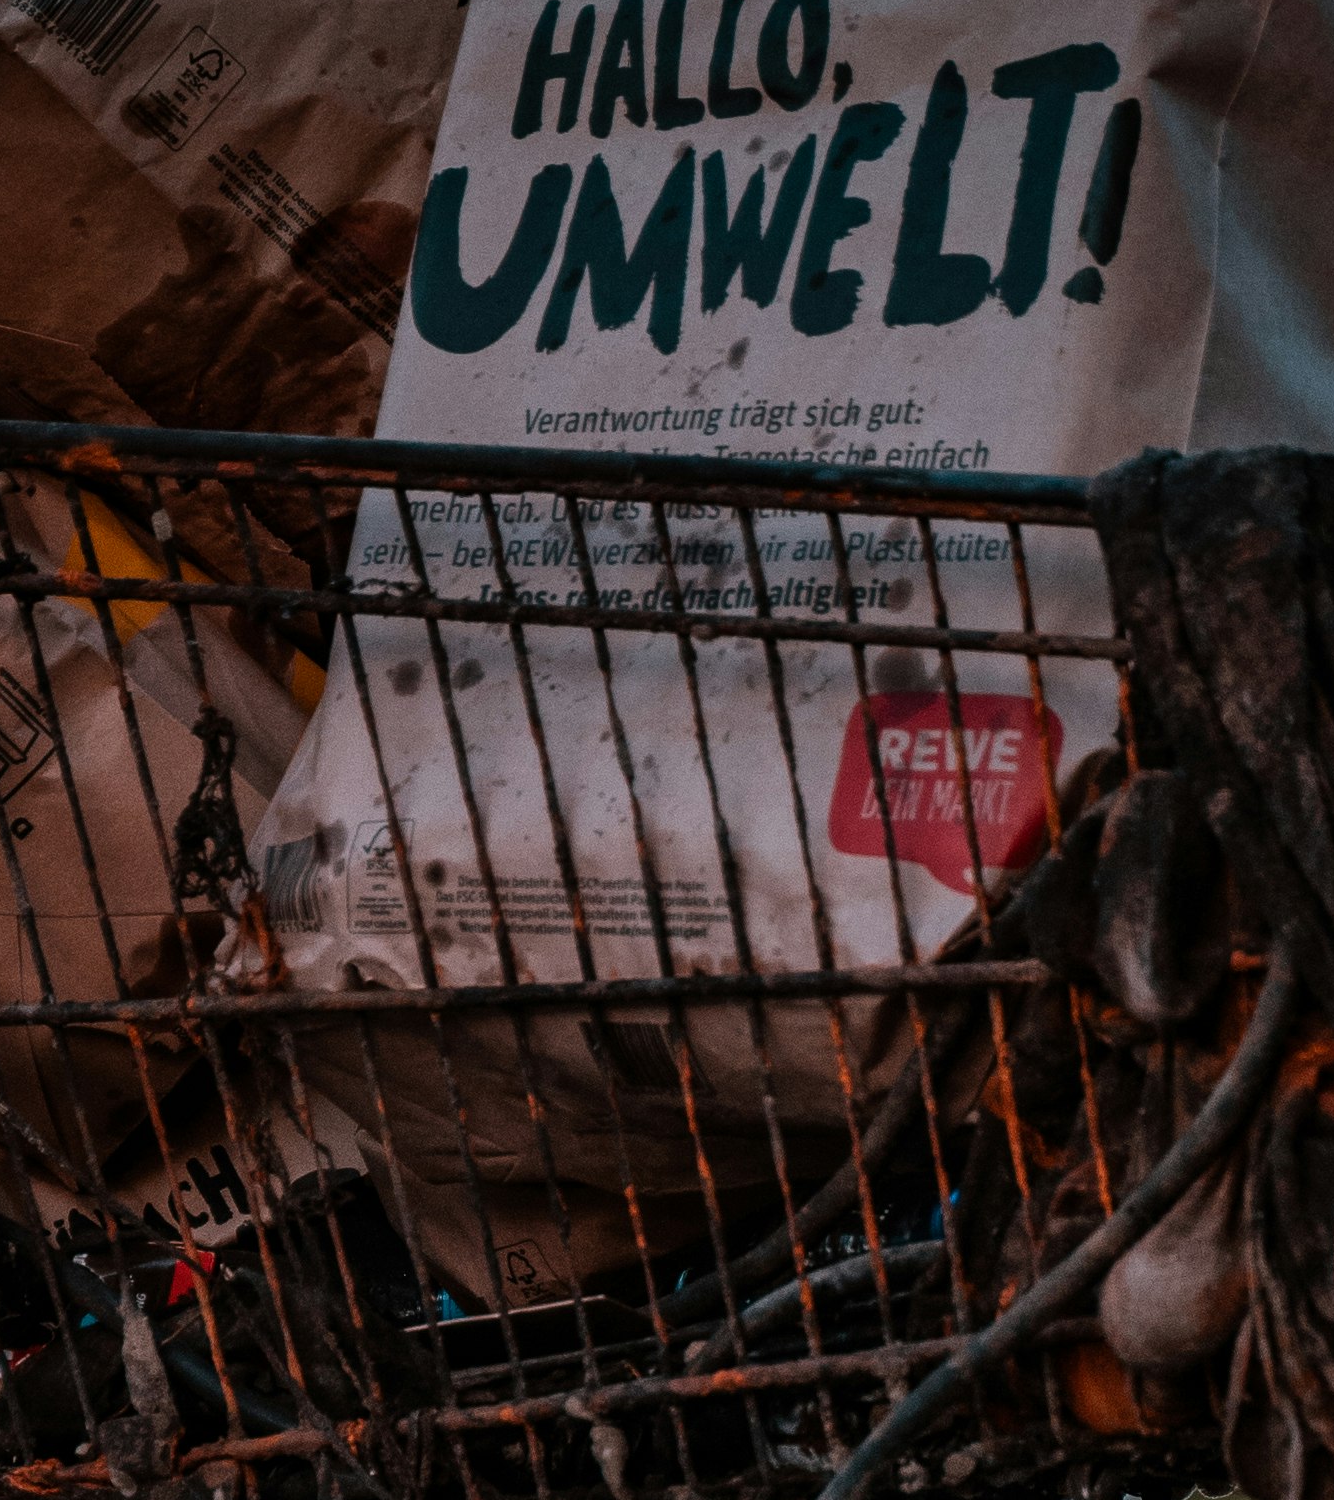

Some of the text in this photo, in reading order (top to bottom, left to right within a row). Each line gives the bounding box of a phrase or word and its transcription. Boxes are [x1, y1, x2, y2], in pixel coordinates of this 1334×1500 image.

[292, 192, 328, 226] besteh
[411, 42, 1141, 355] UMWELT!
[525, 398, 925, 436] Verantwortung trägt sich gut:
[886, 439, 990, 470] einfach
[407, 492, 540, 523] mehrach.
[792, 536, 837, 562] au
[877, 728, 1023, 772] REWE
